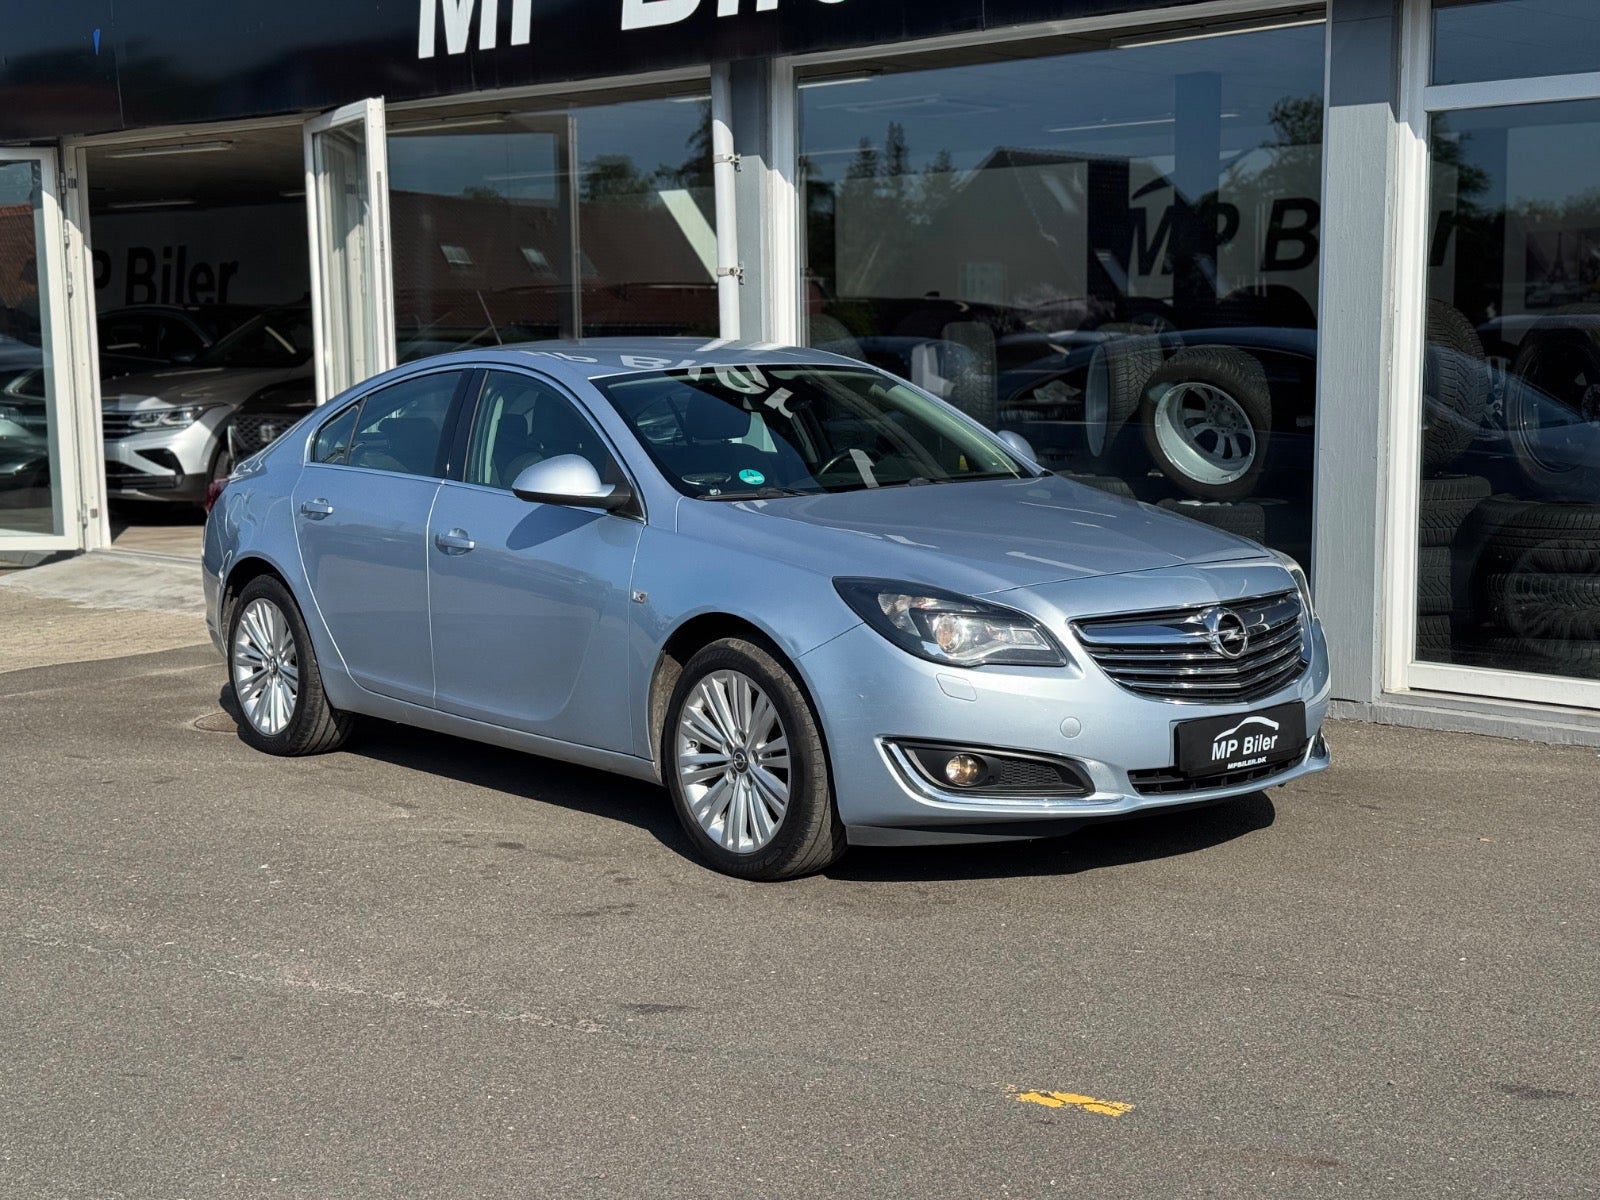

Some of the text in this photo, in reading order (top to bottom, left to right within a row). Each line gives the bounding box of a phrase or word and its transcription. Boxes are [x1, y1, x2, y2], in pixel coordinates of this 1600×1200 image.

[125, 245, 239, 306] Biler
[1211, 734, 1278, 761] MP Biler
